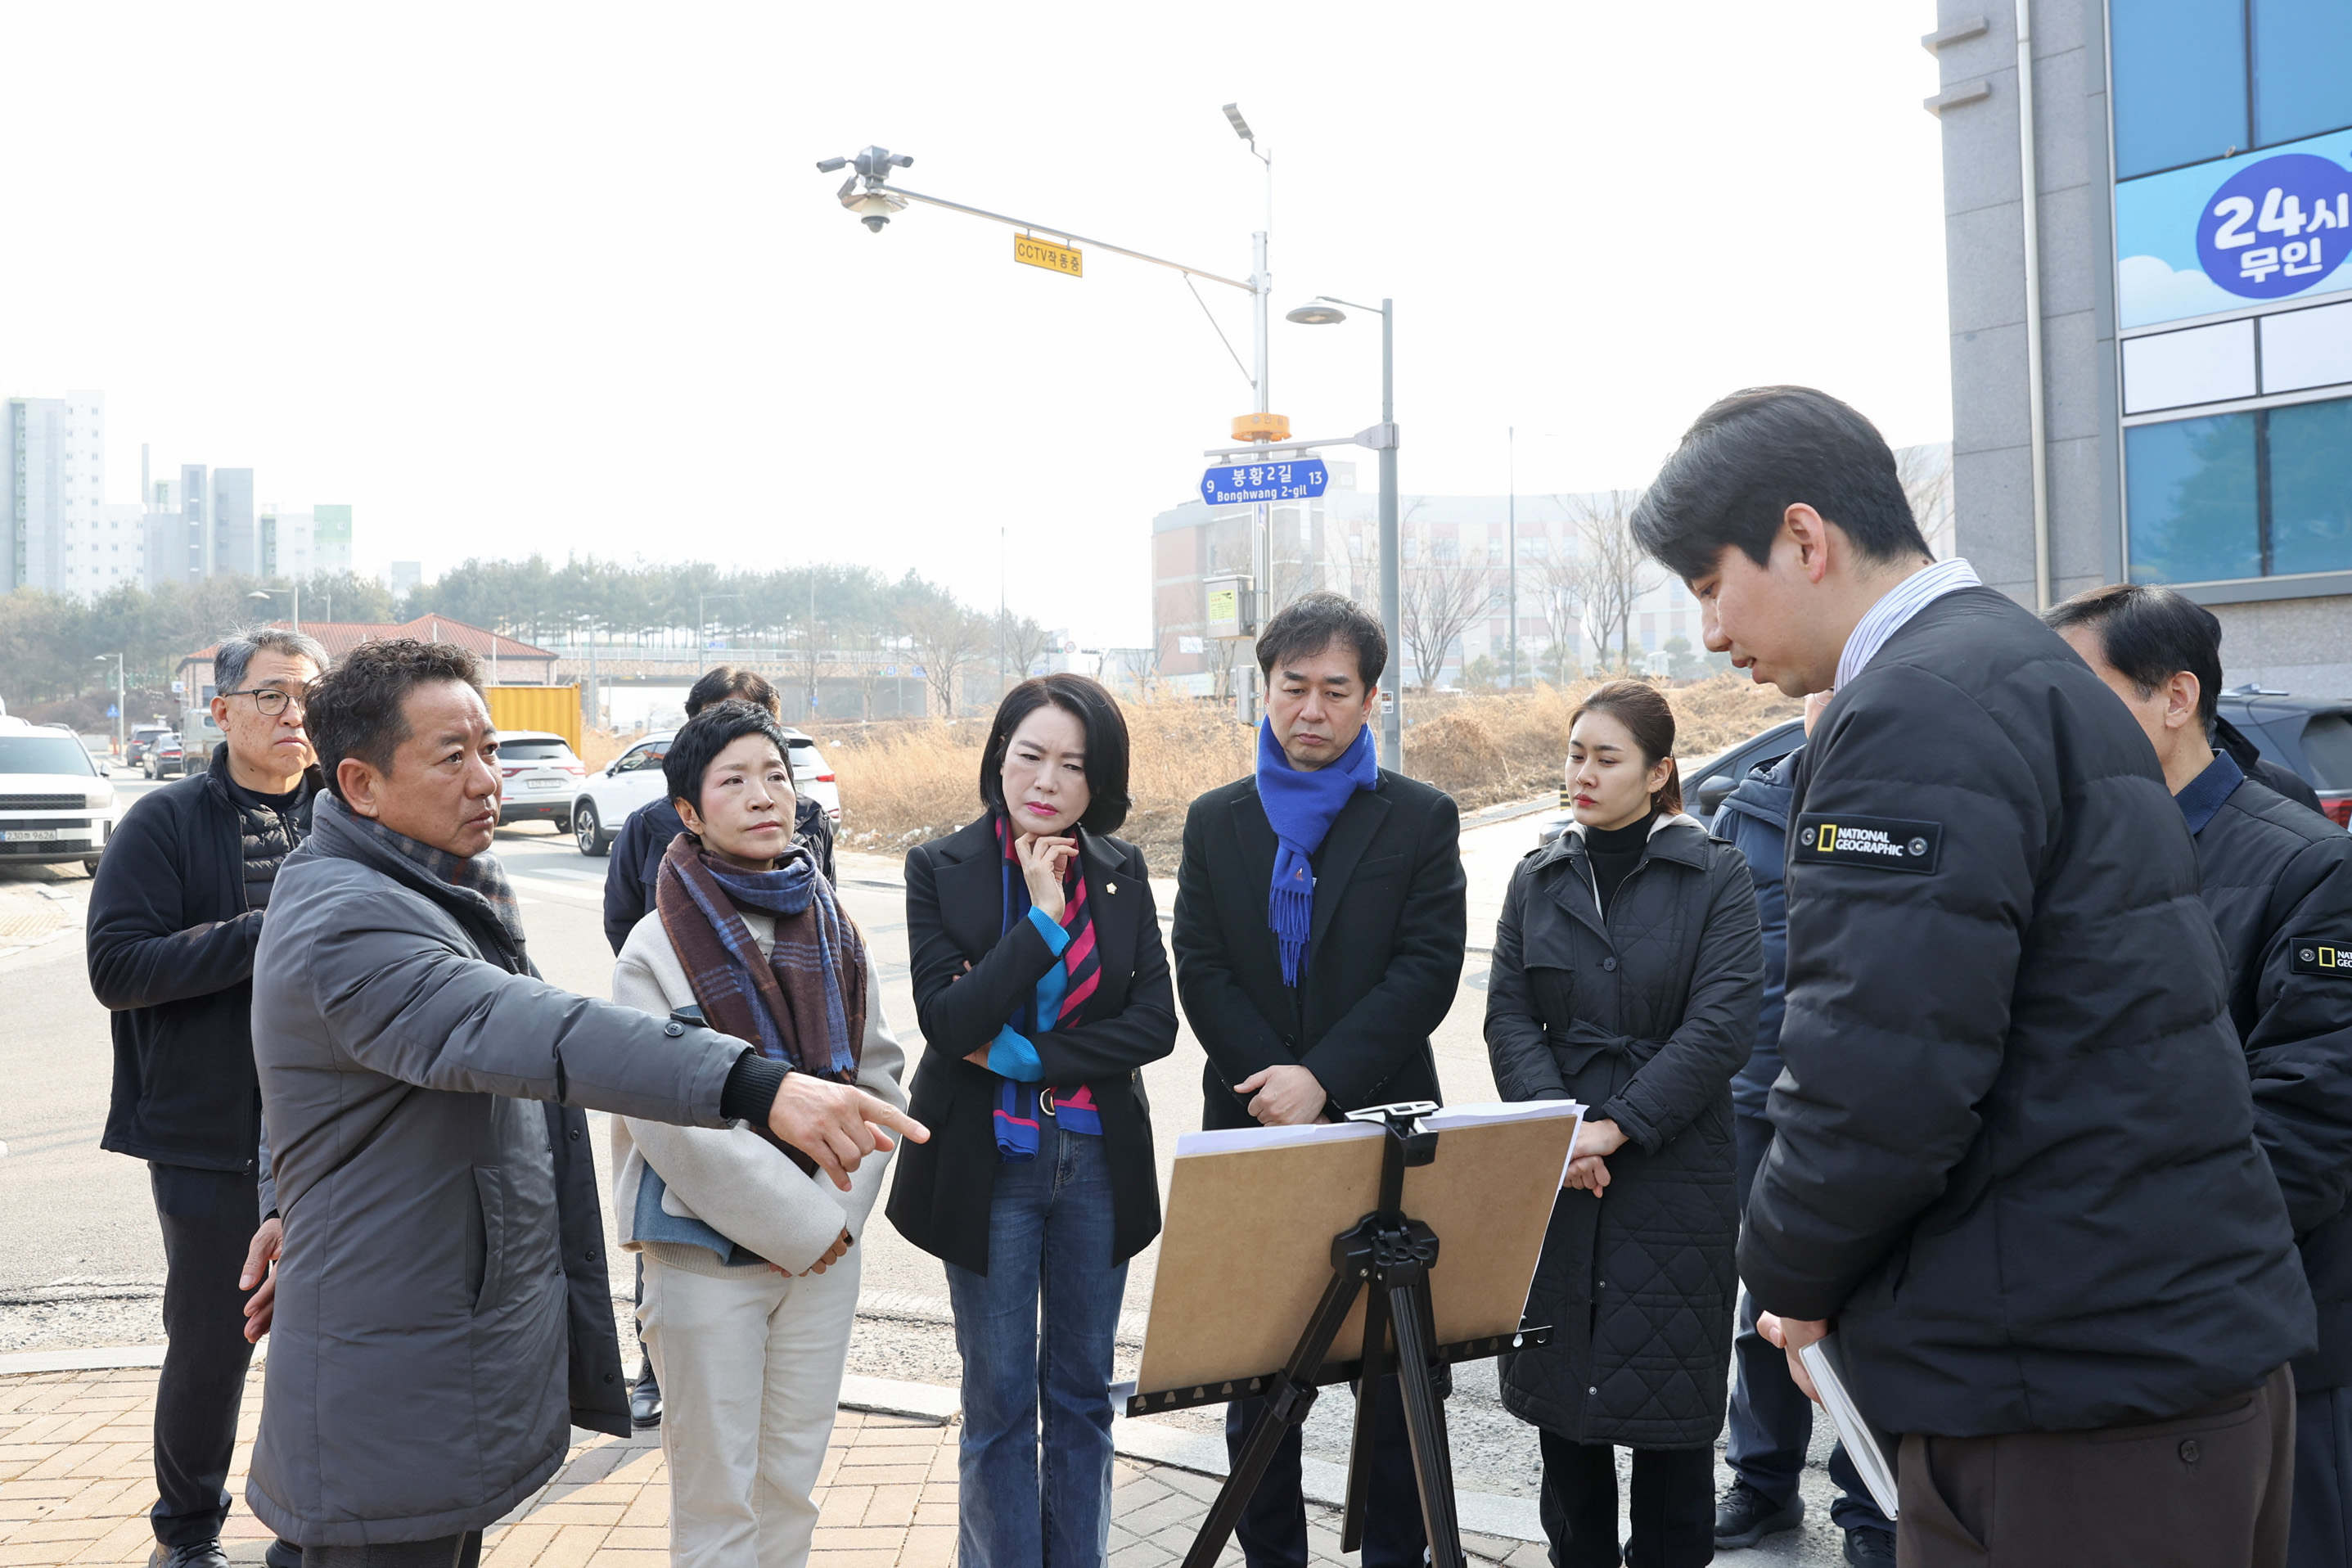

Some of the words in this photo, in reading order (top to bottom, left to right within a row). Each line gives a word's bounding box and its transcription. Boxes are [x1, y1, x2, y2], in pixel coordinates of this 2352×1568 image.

[2214, 187, 2349, 250] 24시
[1017, 243, 1079, 272] CCTV작동중
[2239, 237, 2323, 283] 무인
[1232, 464, 1292, 487] 봉황2길
[1309, 471, 1322, 484] 13
[1206, 480, 1215, 493] 9
[1217, 489, 1277, 502] Bonghwang
[1282, 484, 1307, 498] 2-gil
[33, 831, 55, 840] 9626
[1837, 827, 1890, 844] NATIONAL
[1835, 839, 1904, 857] GEOGRAPHIC
